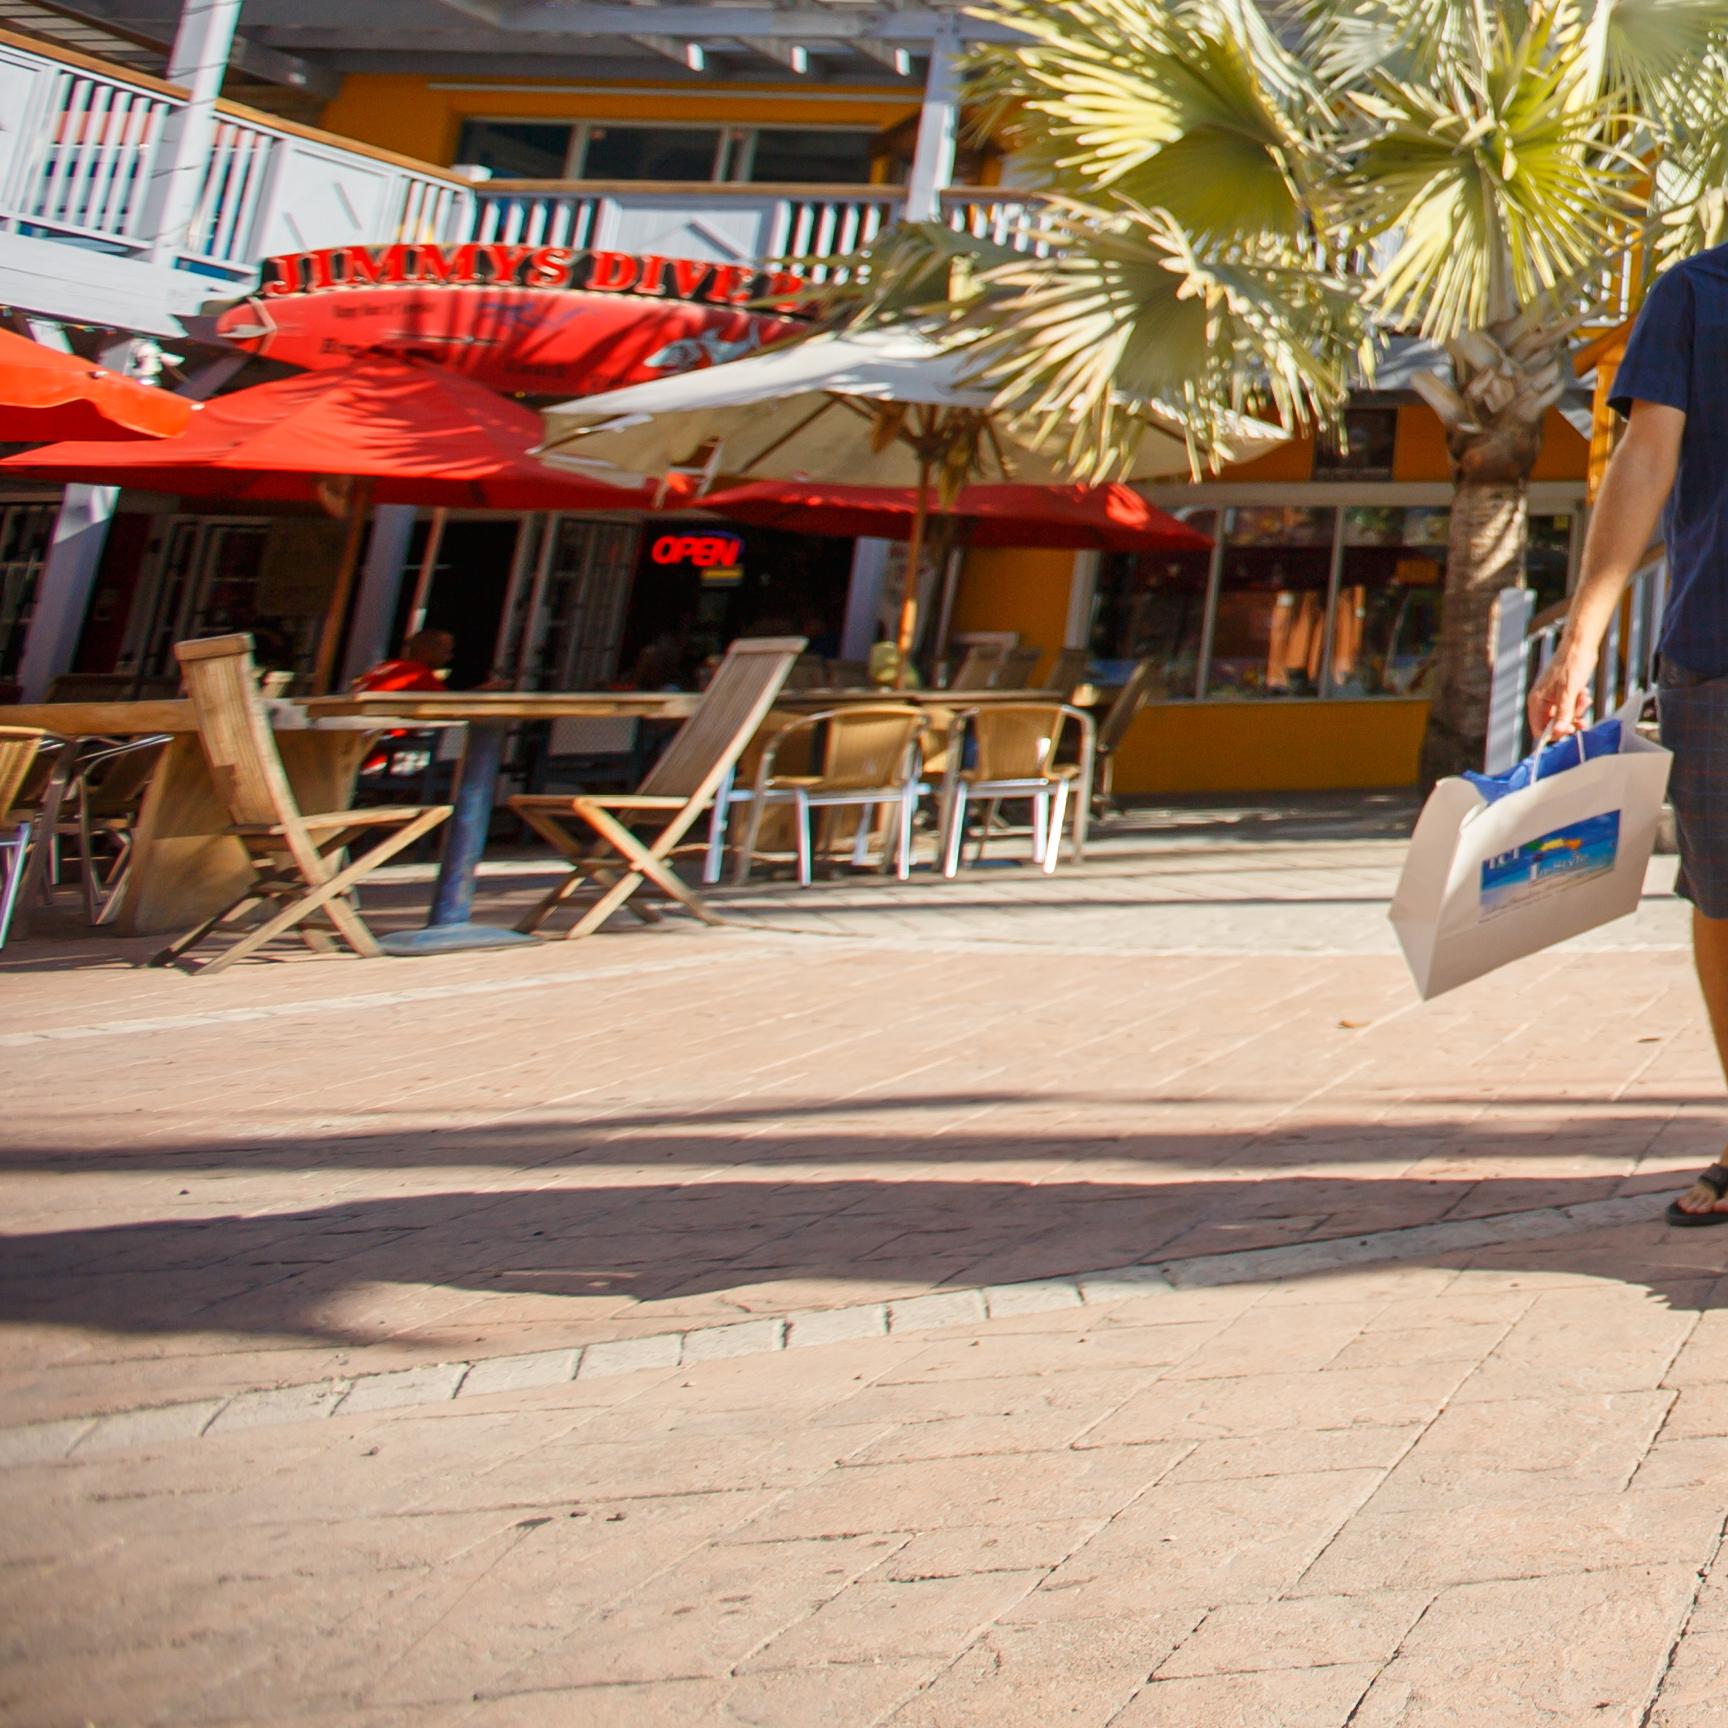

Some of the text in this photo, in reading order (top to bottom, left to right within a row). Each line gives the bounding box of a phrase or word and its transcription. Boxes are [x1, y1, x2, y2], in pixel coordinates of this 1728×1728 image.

[266, 244, 573, 297] JIMMYS
[584, 249, 752, 306] DIVE
[652, 535, 741, 567] OPEN
